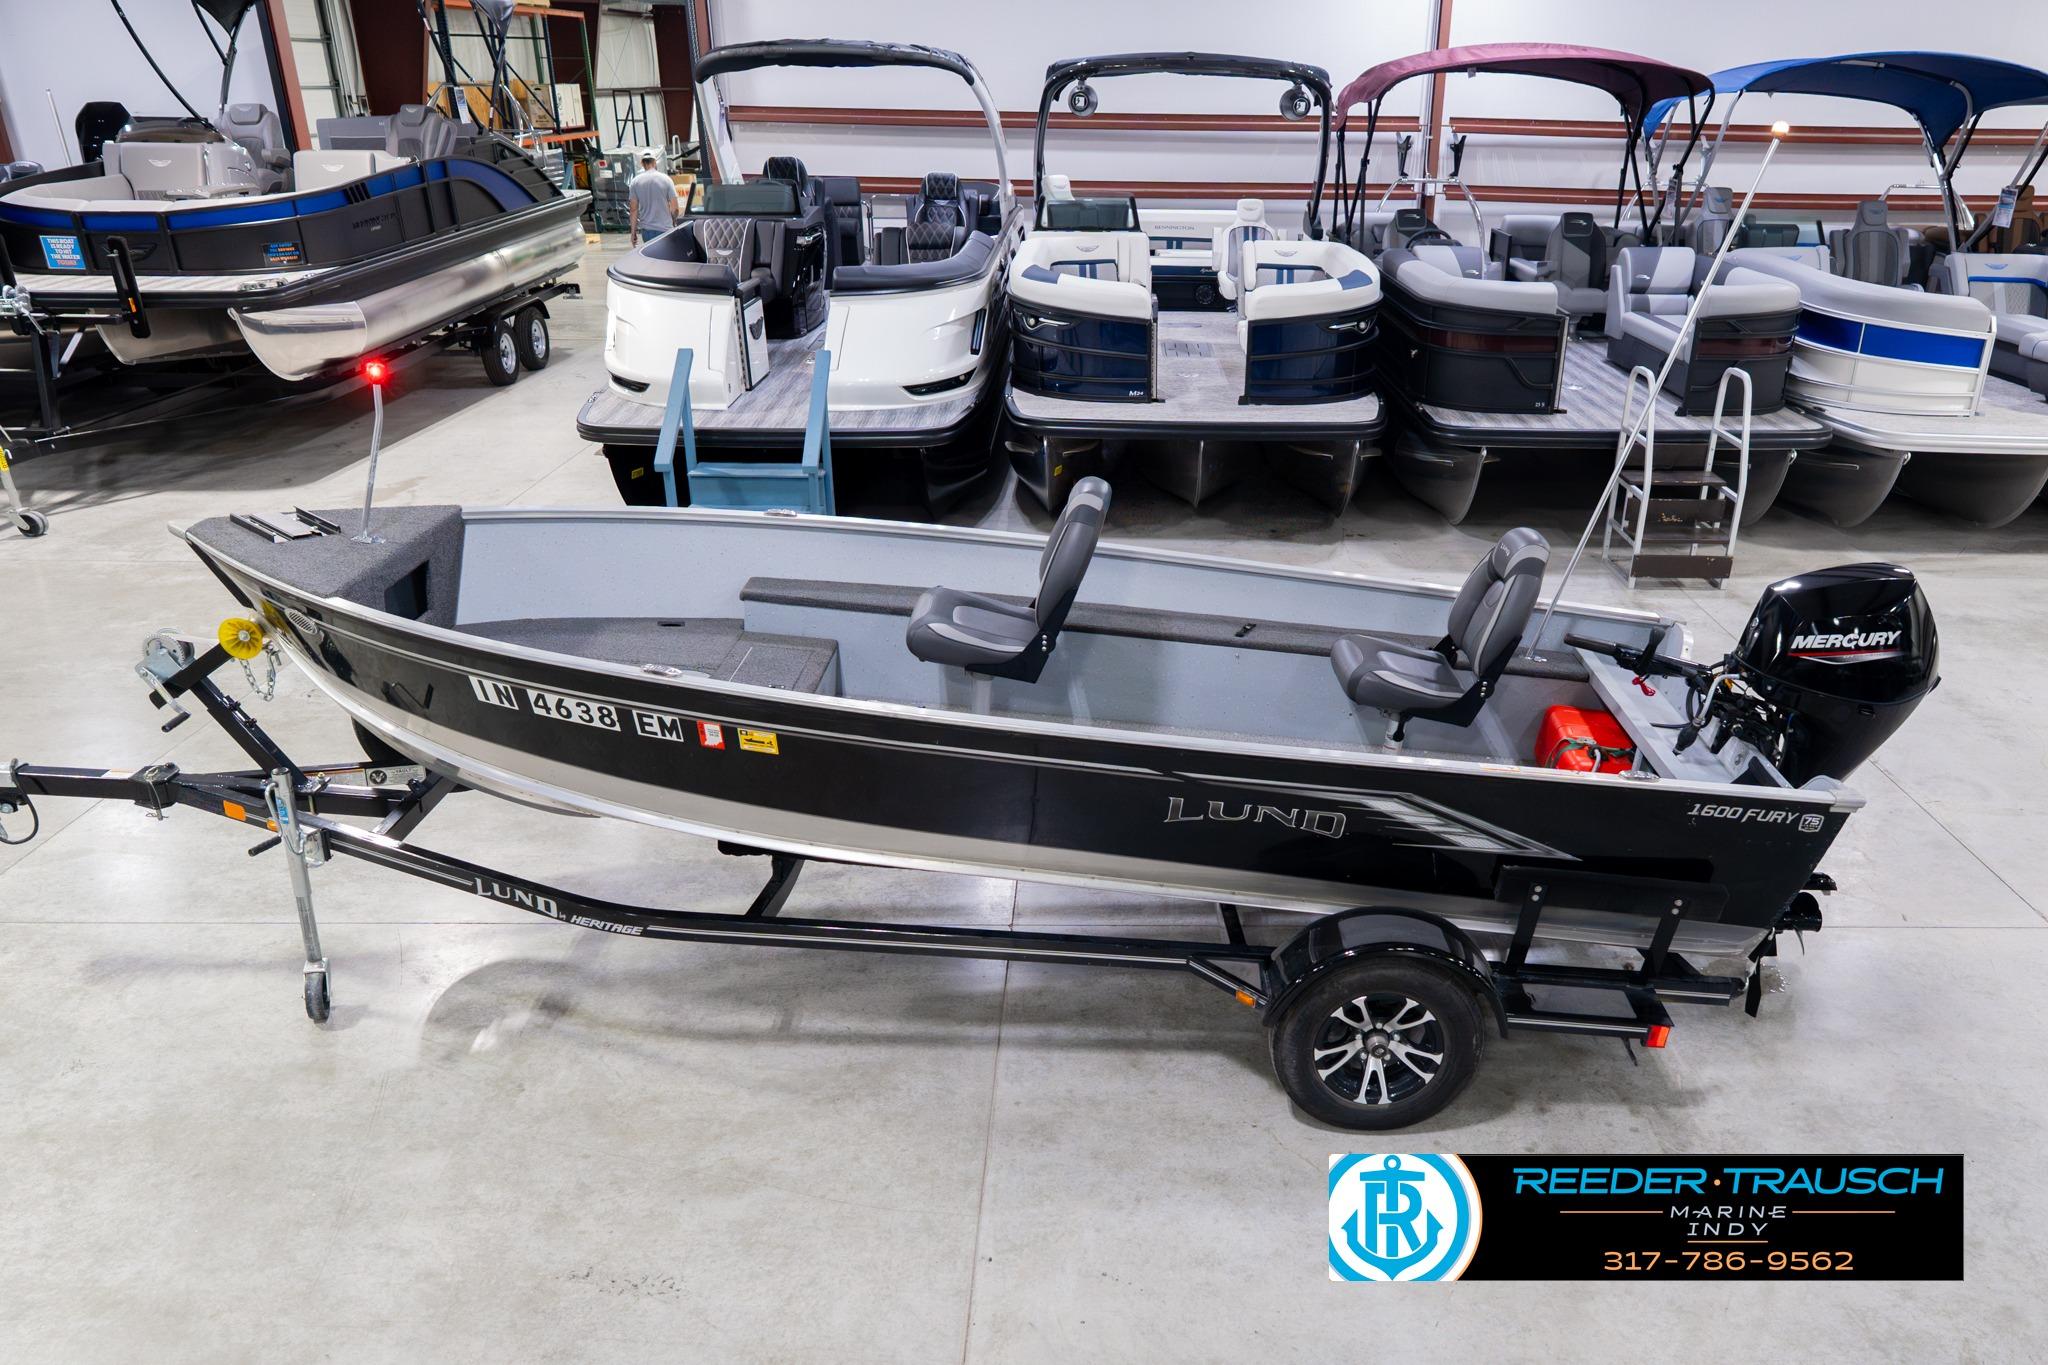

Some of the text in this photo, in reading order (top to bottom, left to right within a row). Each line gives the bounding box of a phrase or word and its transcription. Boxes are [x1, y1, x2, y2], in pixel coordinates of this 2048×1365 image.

[1791, 630, 1902, 650] MERCURY
[477, 679, 683, 741] IN 4638 EM
[1163, 797, 1347, 839] LUND
[1687, 803, 1800, 824] 1600 FURY
[1804, 816, 1820, 825] 75
[474, 877, 560, 919] LUND
[570, 914, 644, 936] HERITAGE
